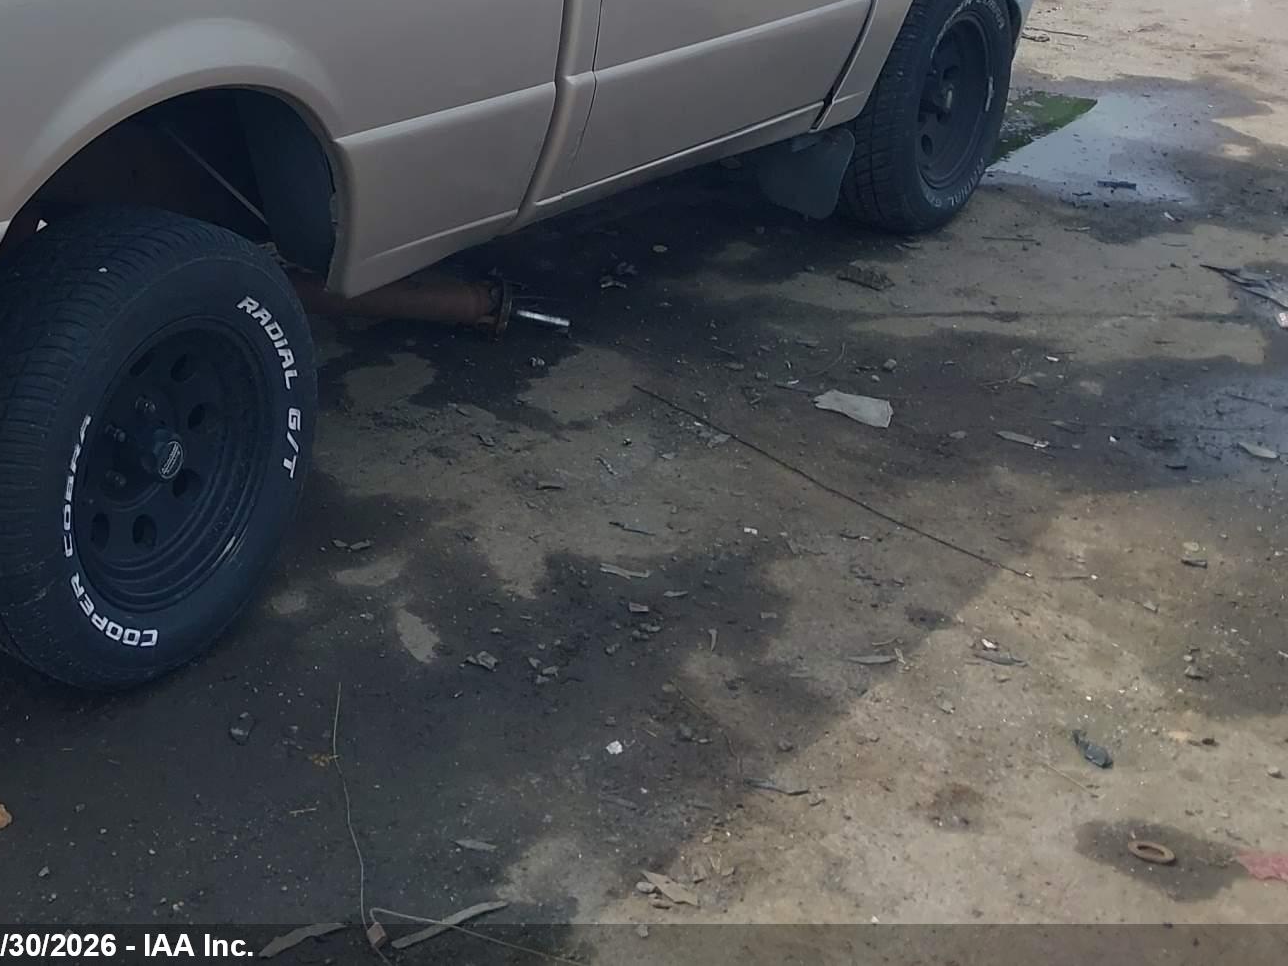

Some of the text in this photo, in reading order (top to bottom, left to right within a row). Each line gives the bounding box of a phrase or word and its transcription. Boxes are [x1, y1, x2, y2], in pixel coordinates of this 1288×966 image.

[236, 296, 301, 479] RADIAL G/T
[63, 414, 159, 647] COOPER COBRA
